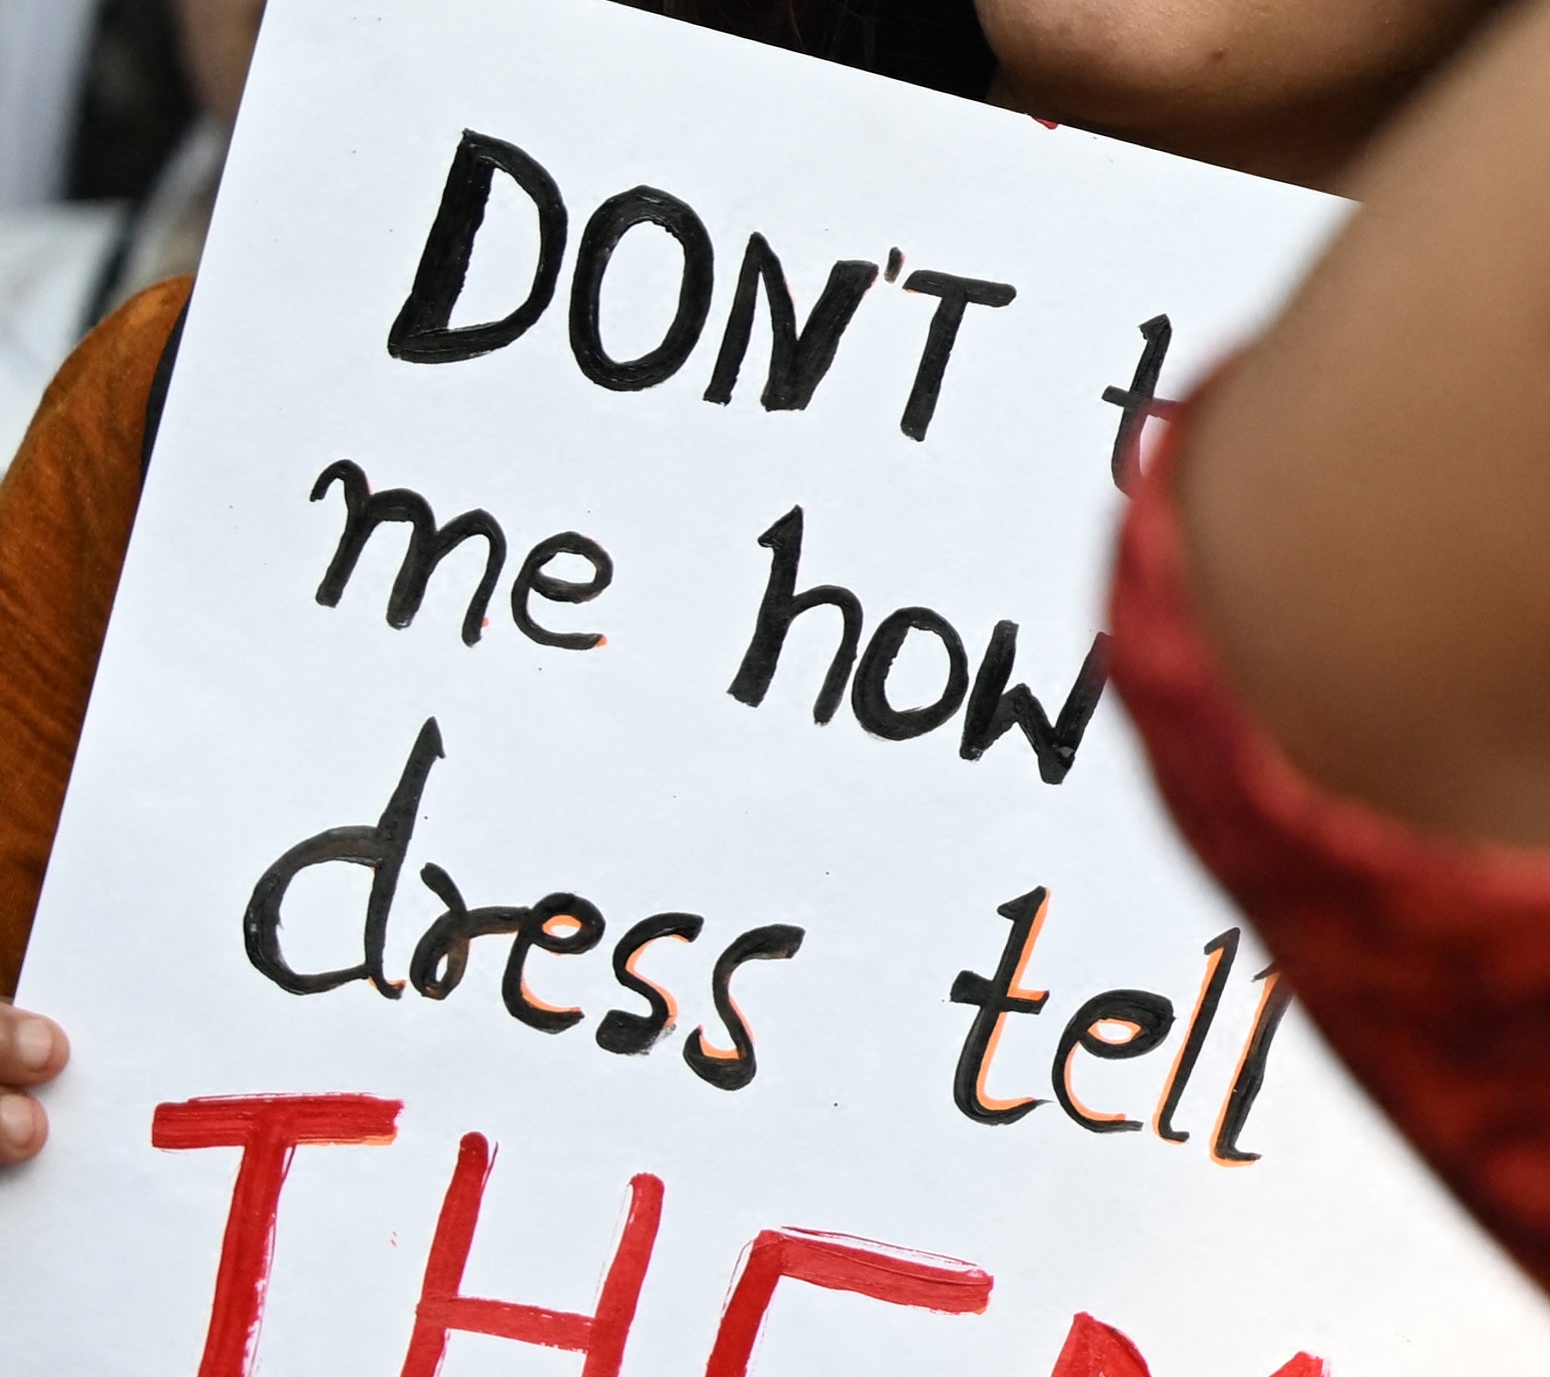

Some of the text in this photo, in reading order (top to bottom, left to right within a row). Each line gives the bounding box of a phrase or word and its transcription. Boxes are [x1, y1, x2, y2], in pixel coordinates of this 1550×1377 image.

[387, 129, 1018, 444] DON'T
[308, 458, 1110, 787] me how
[243, 717, 1292, 1167] dress tell
